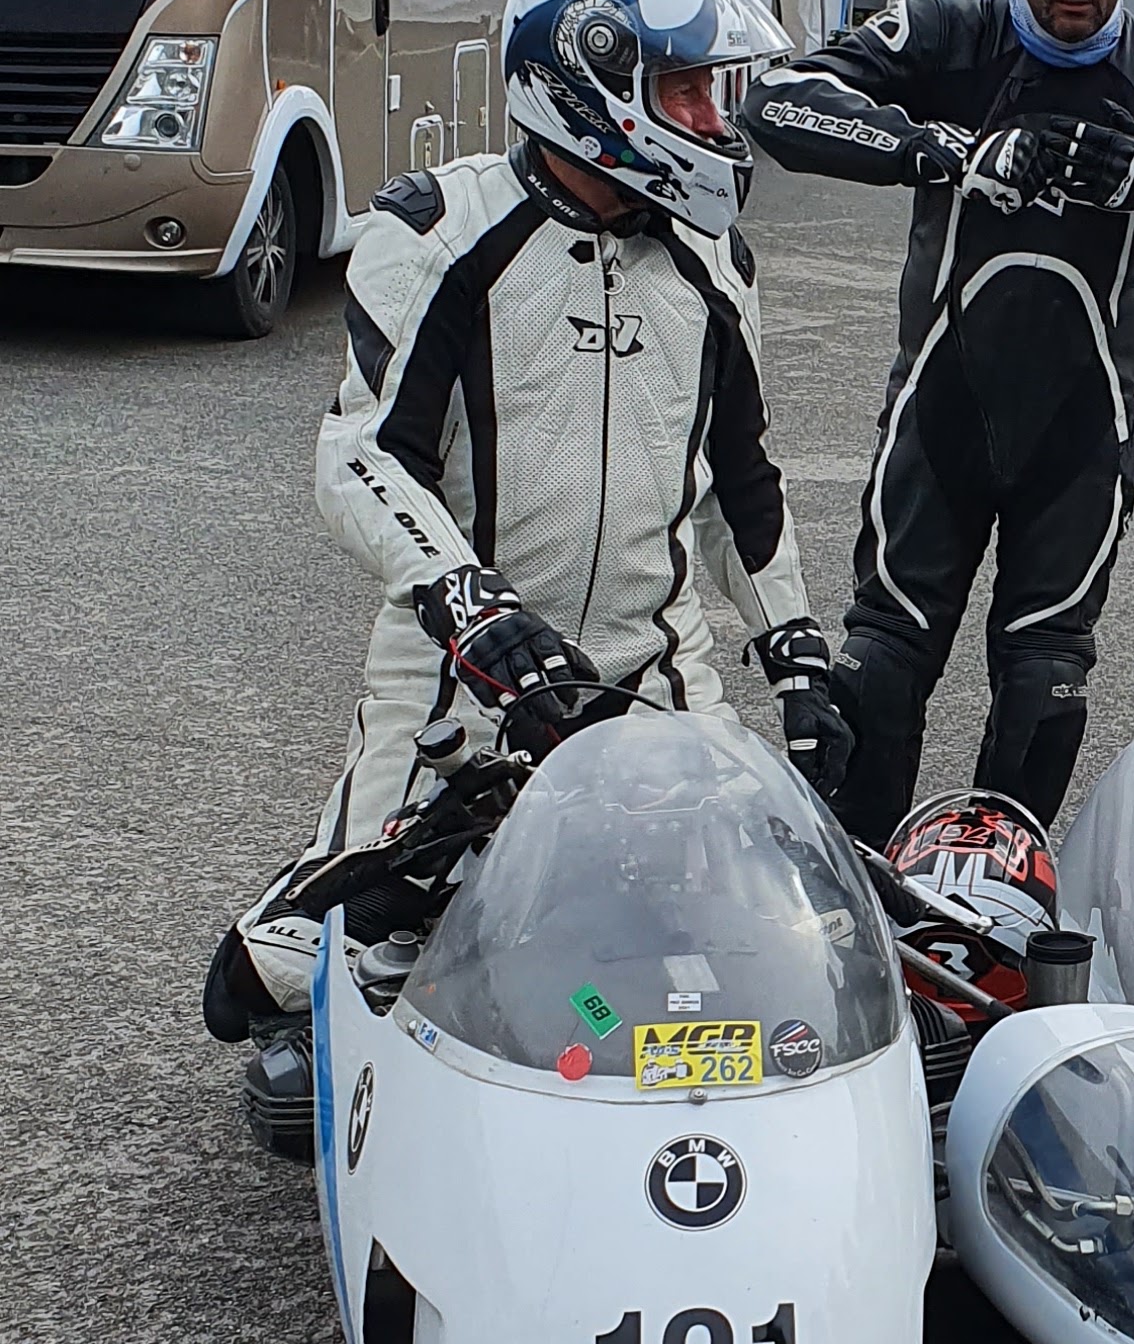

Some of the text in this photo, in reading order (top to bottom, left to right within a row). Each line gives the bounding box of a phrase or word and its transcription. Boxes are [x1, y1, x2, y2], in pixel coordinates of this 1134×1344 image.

[761, 101, 901, 152] alpinestars
[346, 457, 442, 559] ALL ONE
[769, 1038, 821, 1058] FSCC
[700, 1055, 754, 1083] 262
[657, 1138, 736, 1169] BMW
